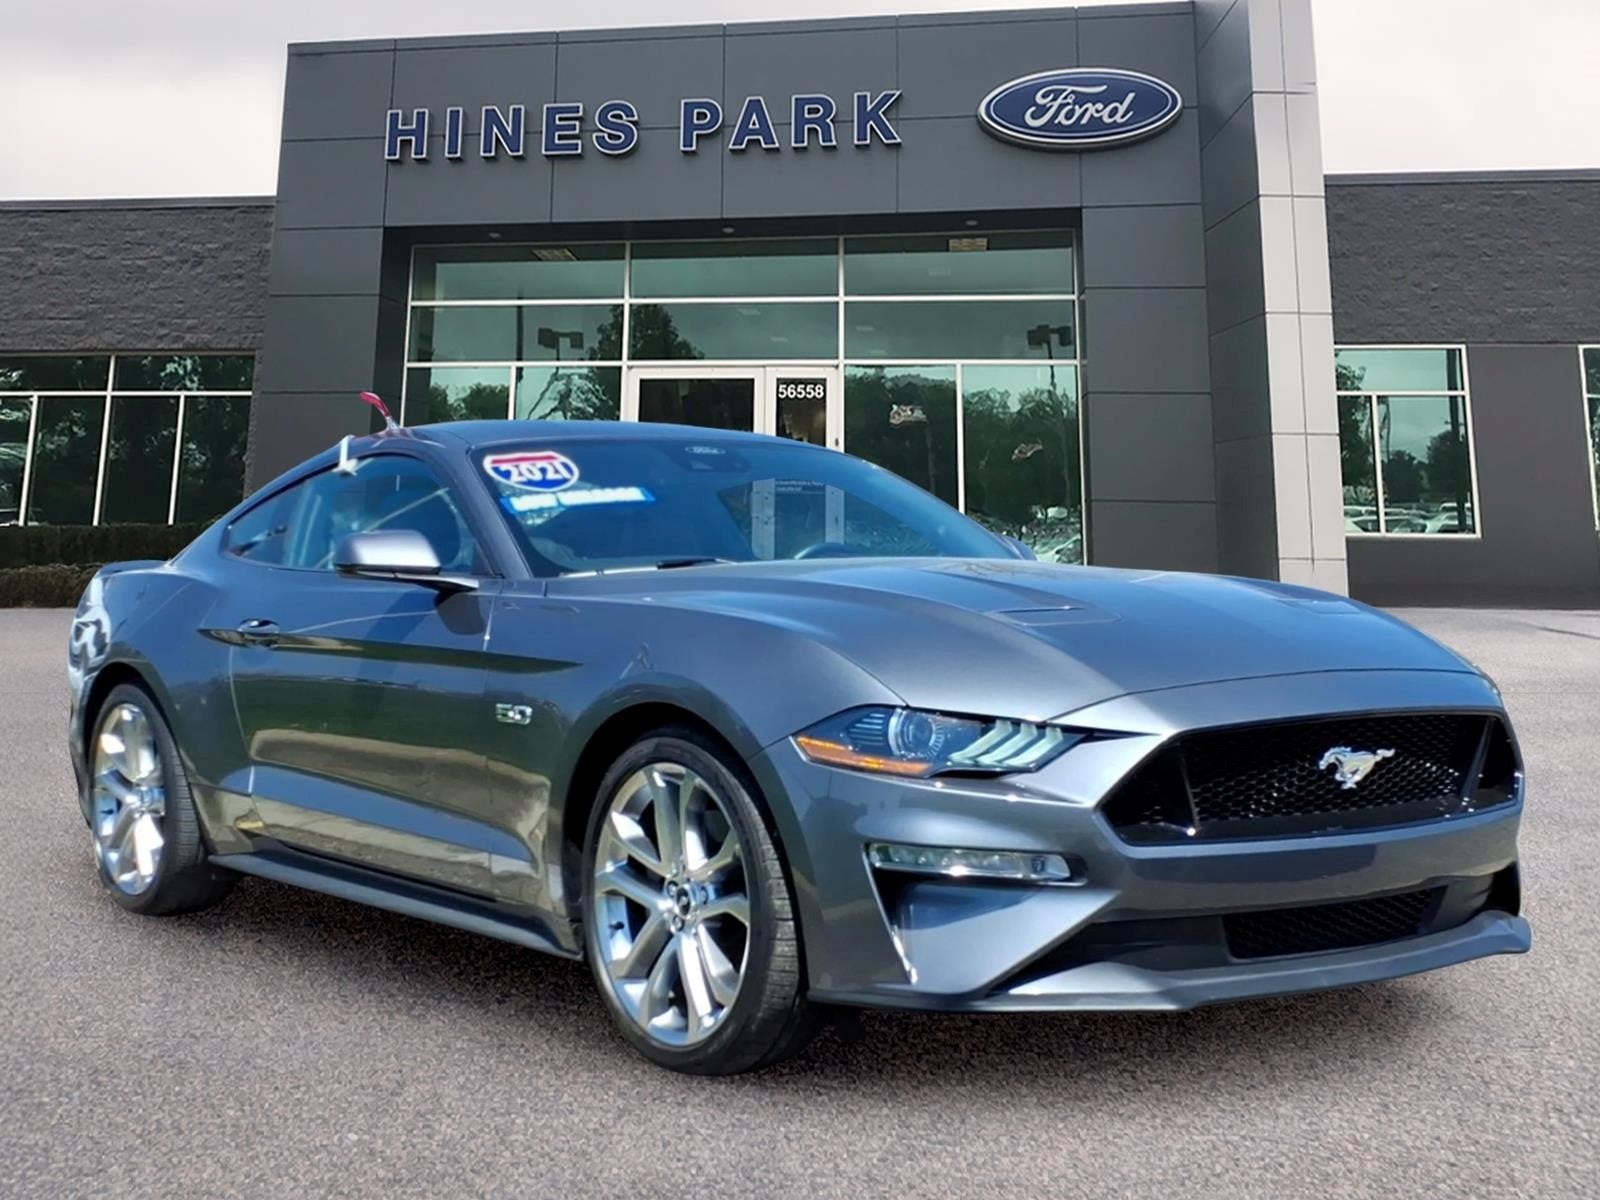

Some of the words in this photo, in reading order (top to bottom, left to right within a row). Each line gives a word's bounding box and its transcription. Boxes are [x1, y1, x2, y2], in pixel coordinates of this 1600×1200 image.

[1024, 85, 1136, 127] Ford
[385, 100, 638, 159] HINES
[680, 90, 902, 152] PARK
[778, 384, 824, 399] 56558
[500, 461, 572, 482] 2021
